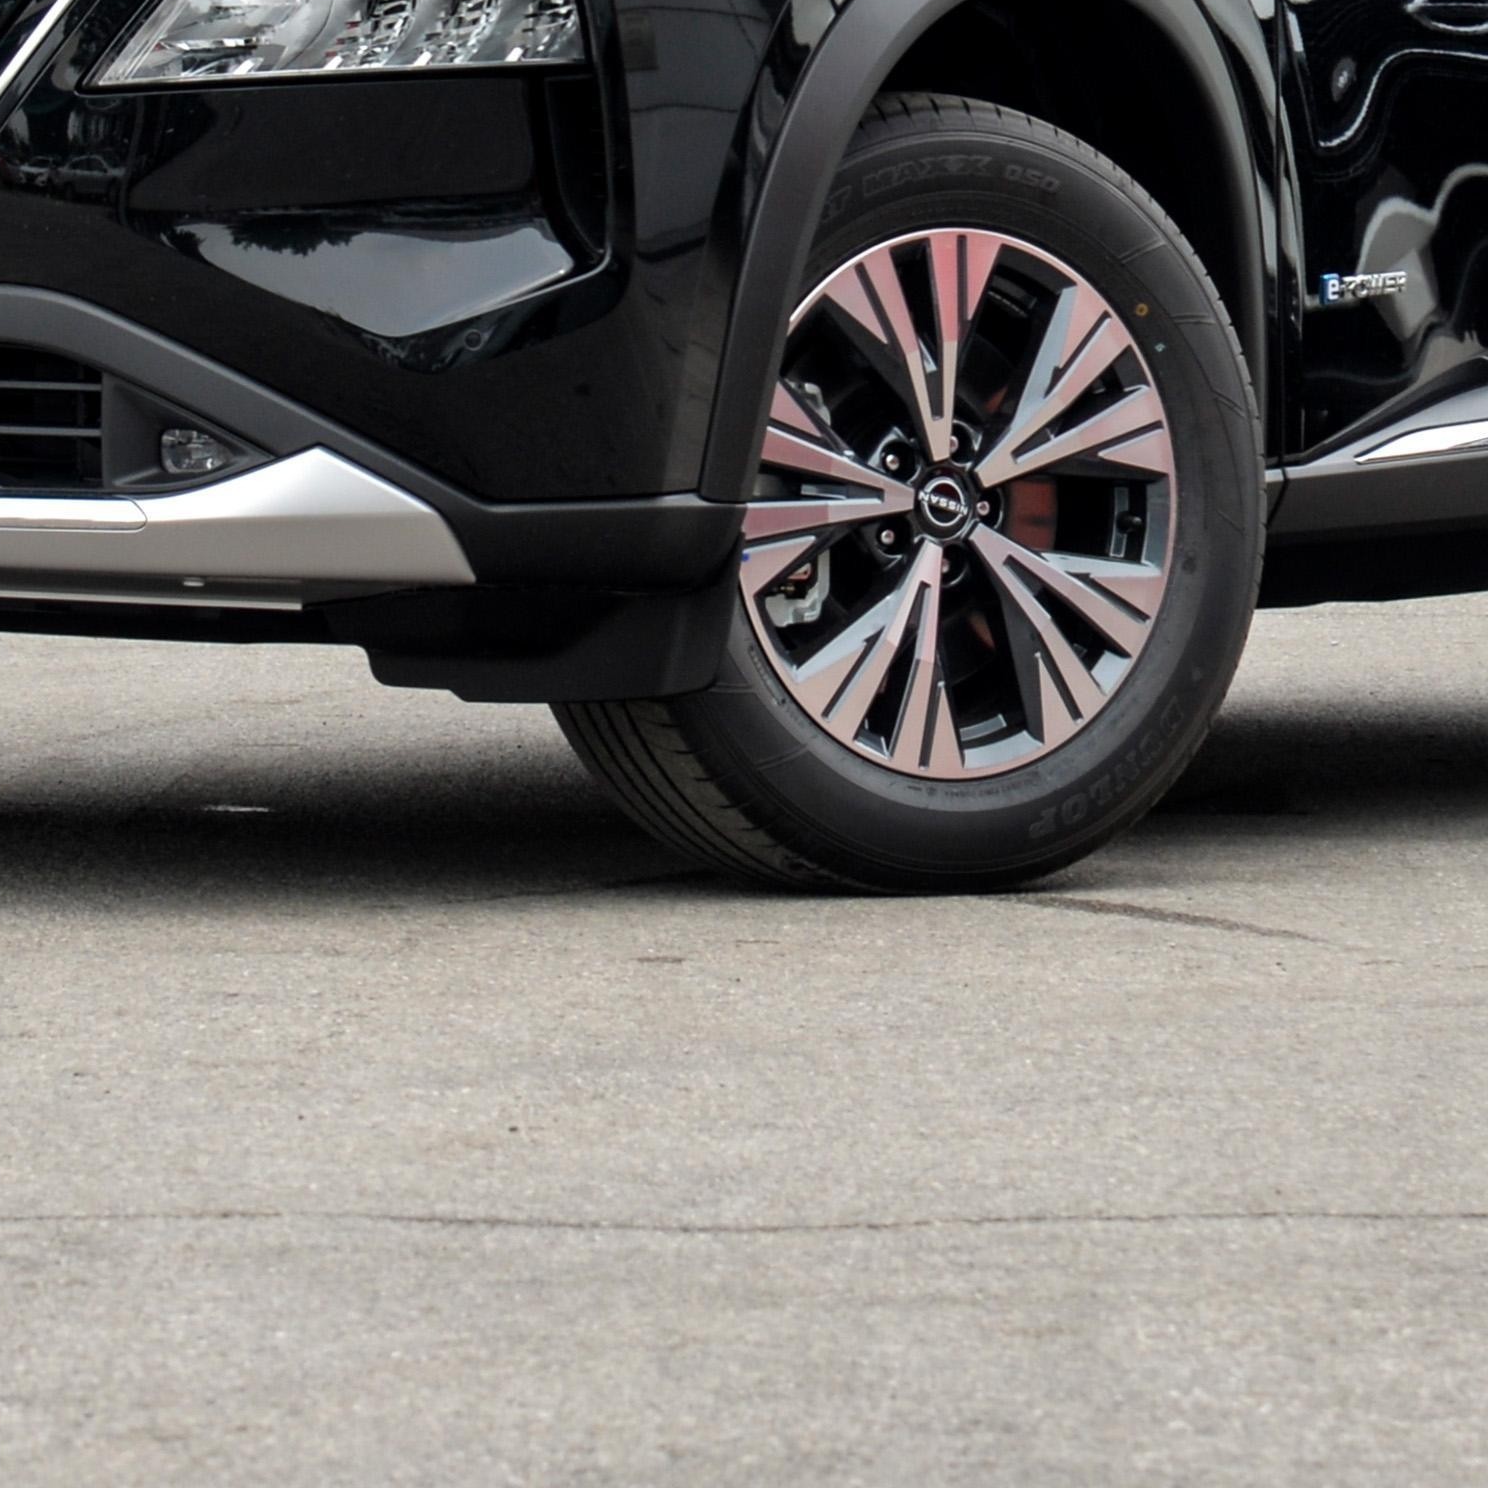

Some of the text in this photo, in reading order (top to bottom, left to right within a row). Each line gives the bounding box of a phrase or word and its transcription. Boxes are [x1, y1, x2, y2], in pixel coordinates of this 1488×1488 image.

[862, 154, 995, 197] MAXX
[917, 489, 969, 517] NISSAN
[1027, 696, 1186, 838] DUNLOP
